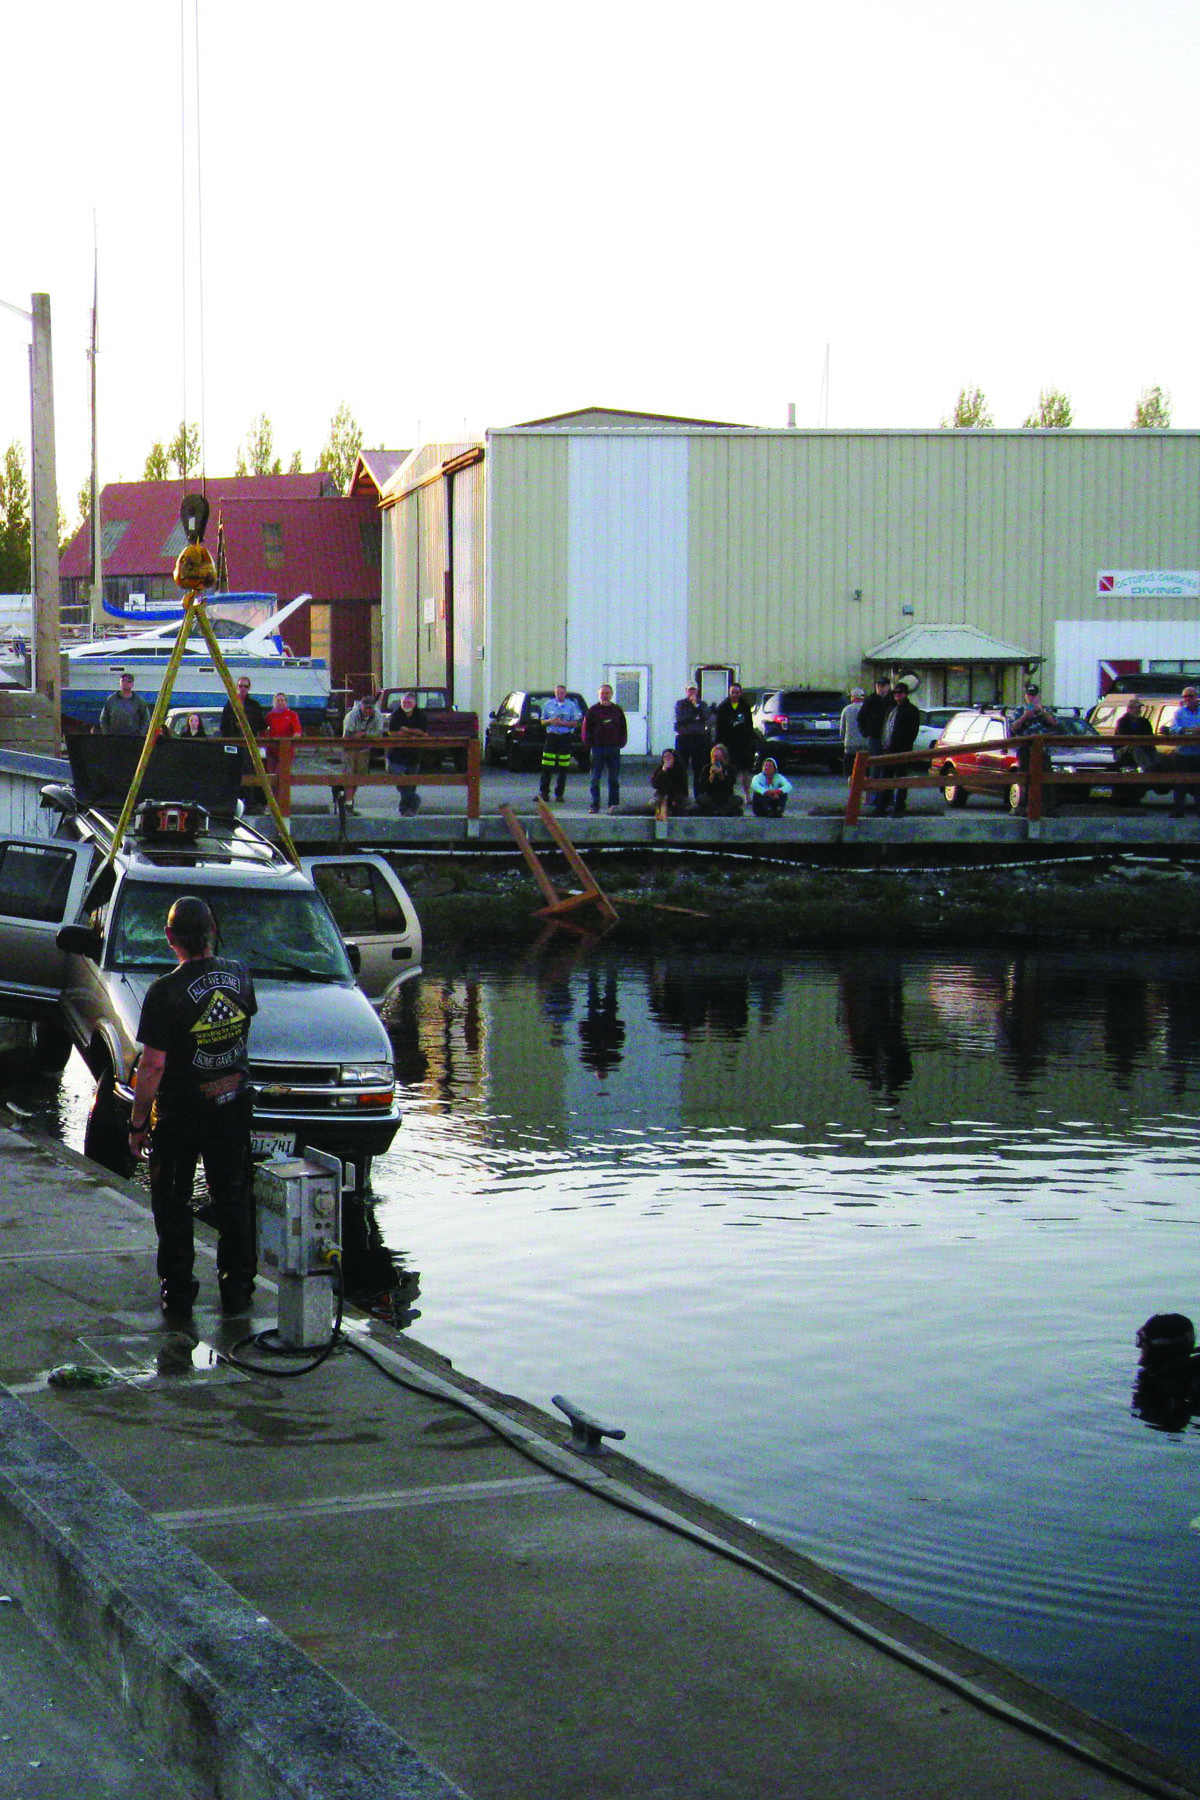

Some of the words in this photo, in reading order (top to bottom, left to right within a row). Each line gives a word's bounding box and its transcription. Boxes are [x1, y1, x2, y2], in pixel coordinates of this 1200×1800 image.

[192, 982, 205, 998] ALL
[221, 974, 238, 989] SOME
[195, 1028, 221, 1040] Standing
[196, 1036, 212, 1046] Who
[212, 1032, 228, 1044] Stood
[196, 1054, 215, 1067] SOME
[215, 1052, 234, 1067] GAVE
